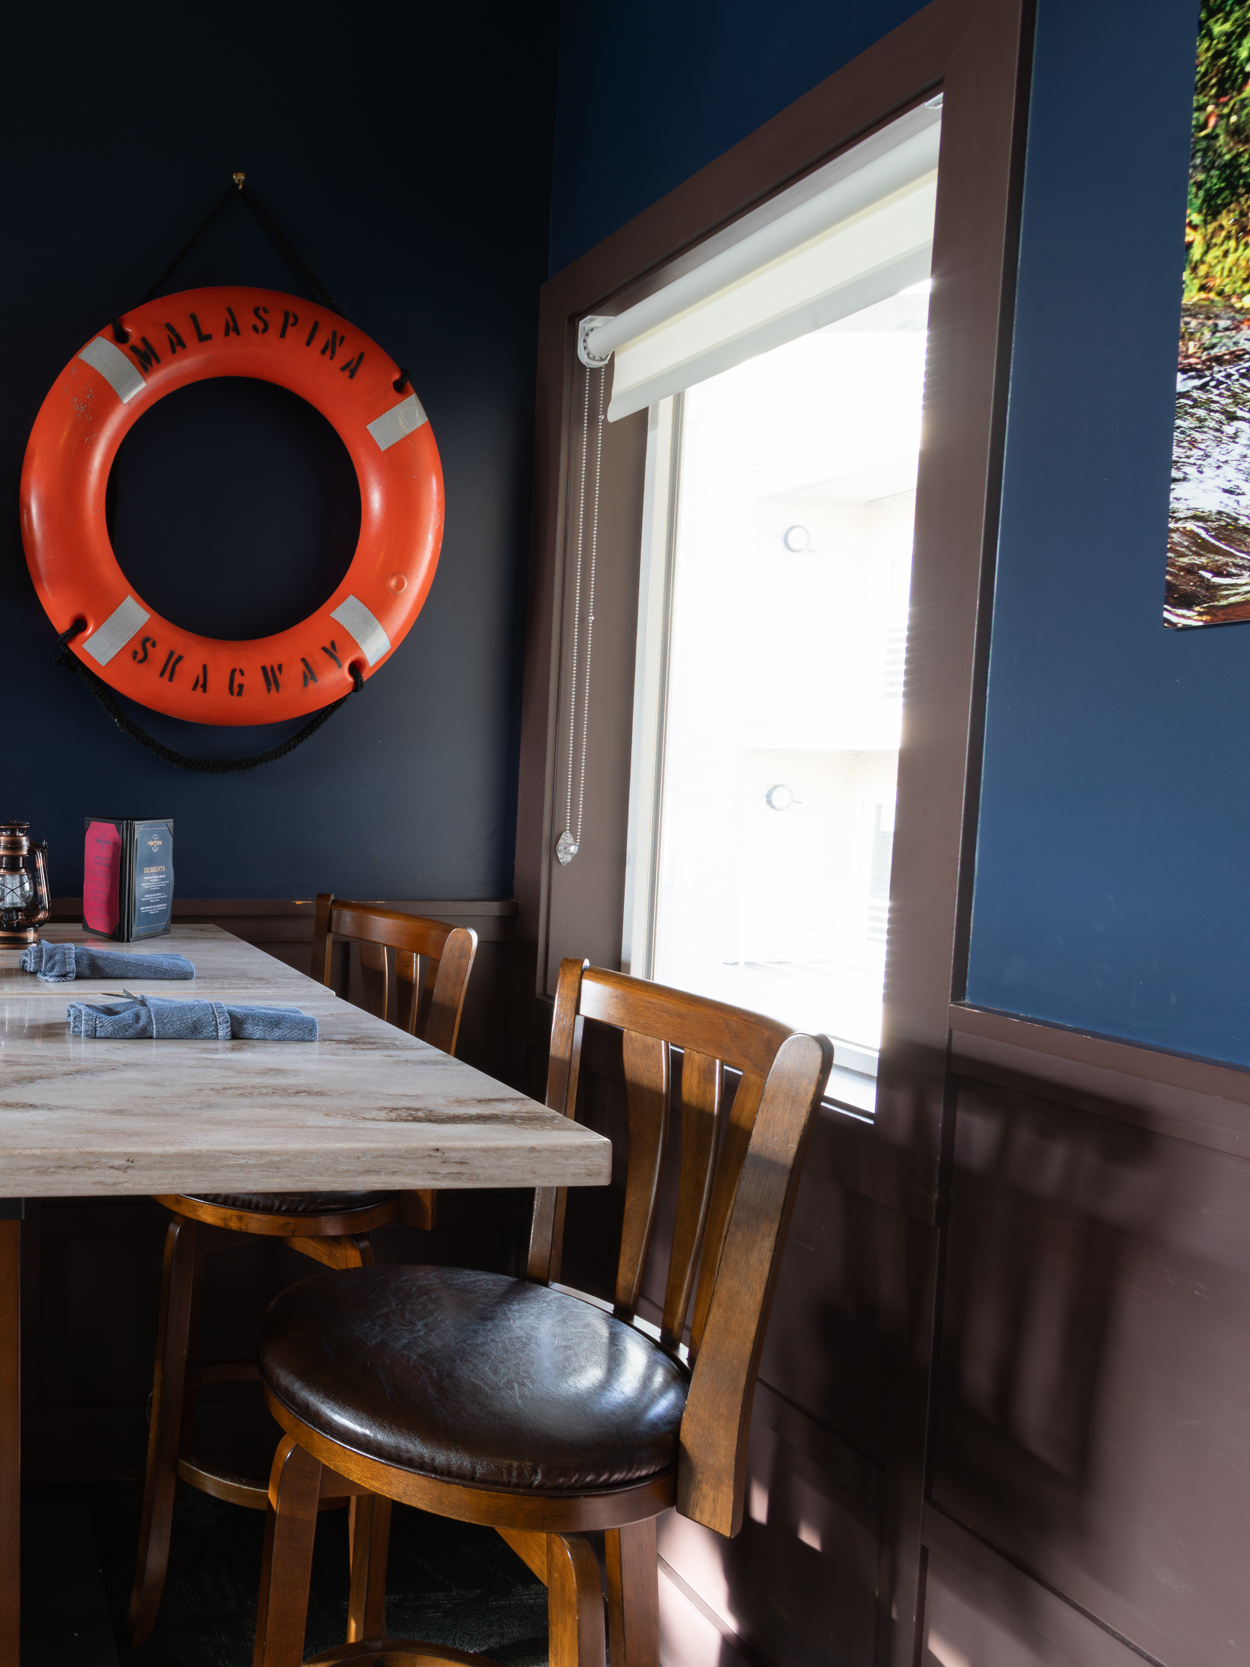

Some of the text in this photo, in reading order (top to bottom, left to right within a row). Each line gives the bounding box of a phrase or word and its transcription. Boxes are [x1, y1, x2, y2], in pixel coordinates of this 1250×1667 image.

[129, 305, 366, 380] MALASPINA
[131, 636, 344, 697] SKAGWAY
[144, 865, 166, 874] DESSERTS
